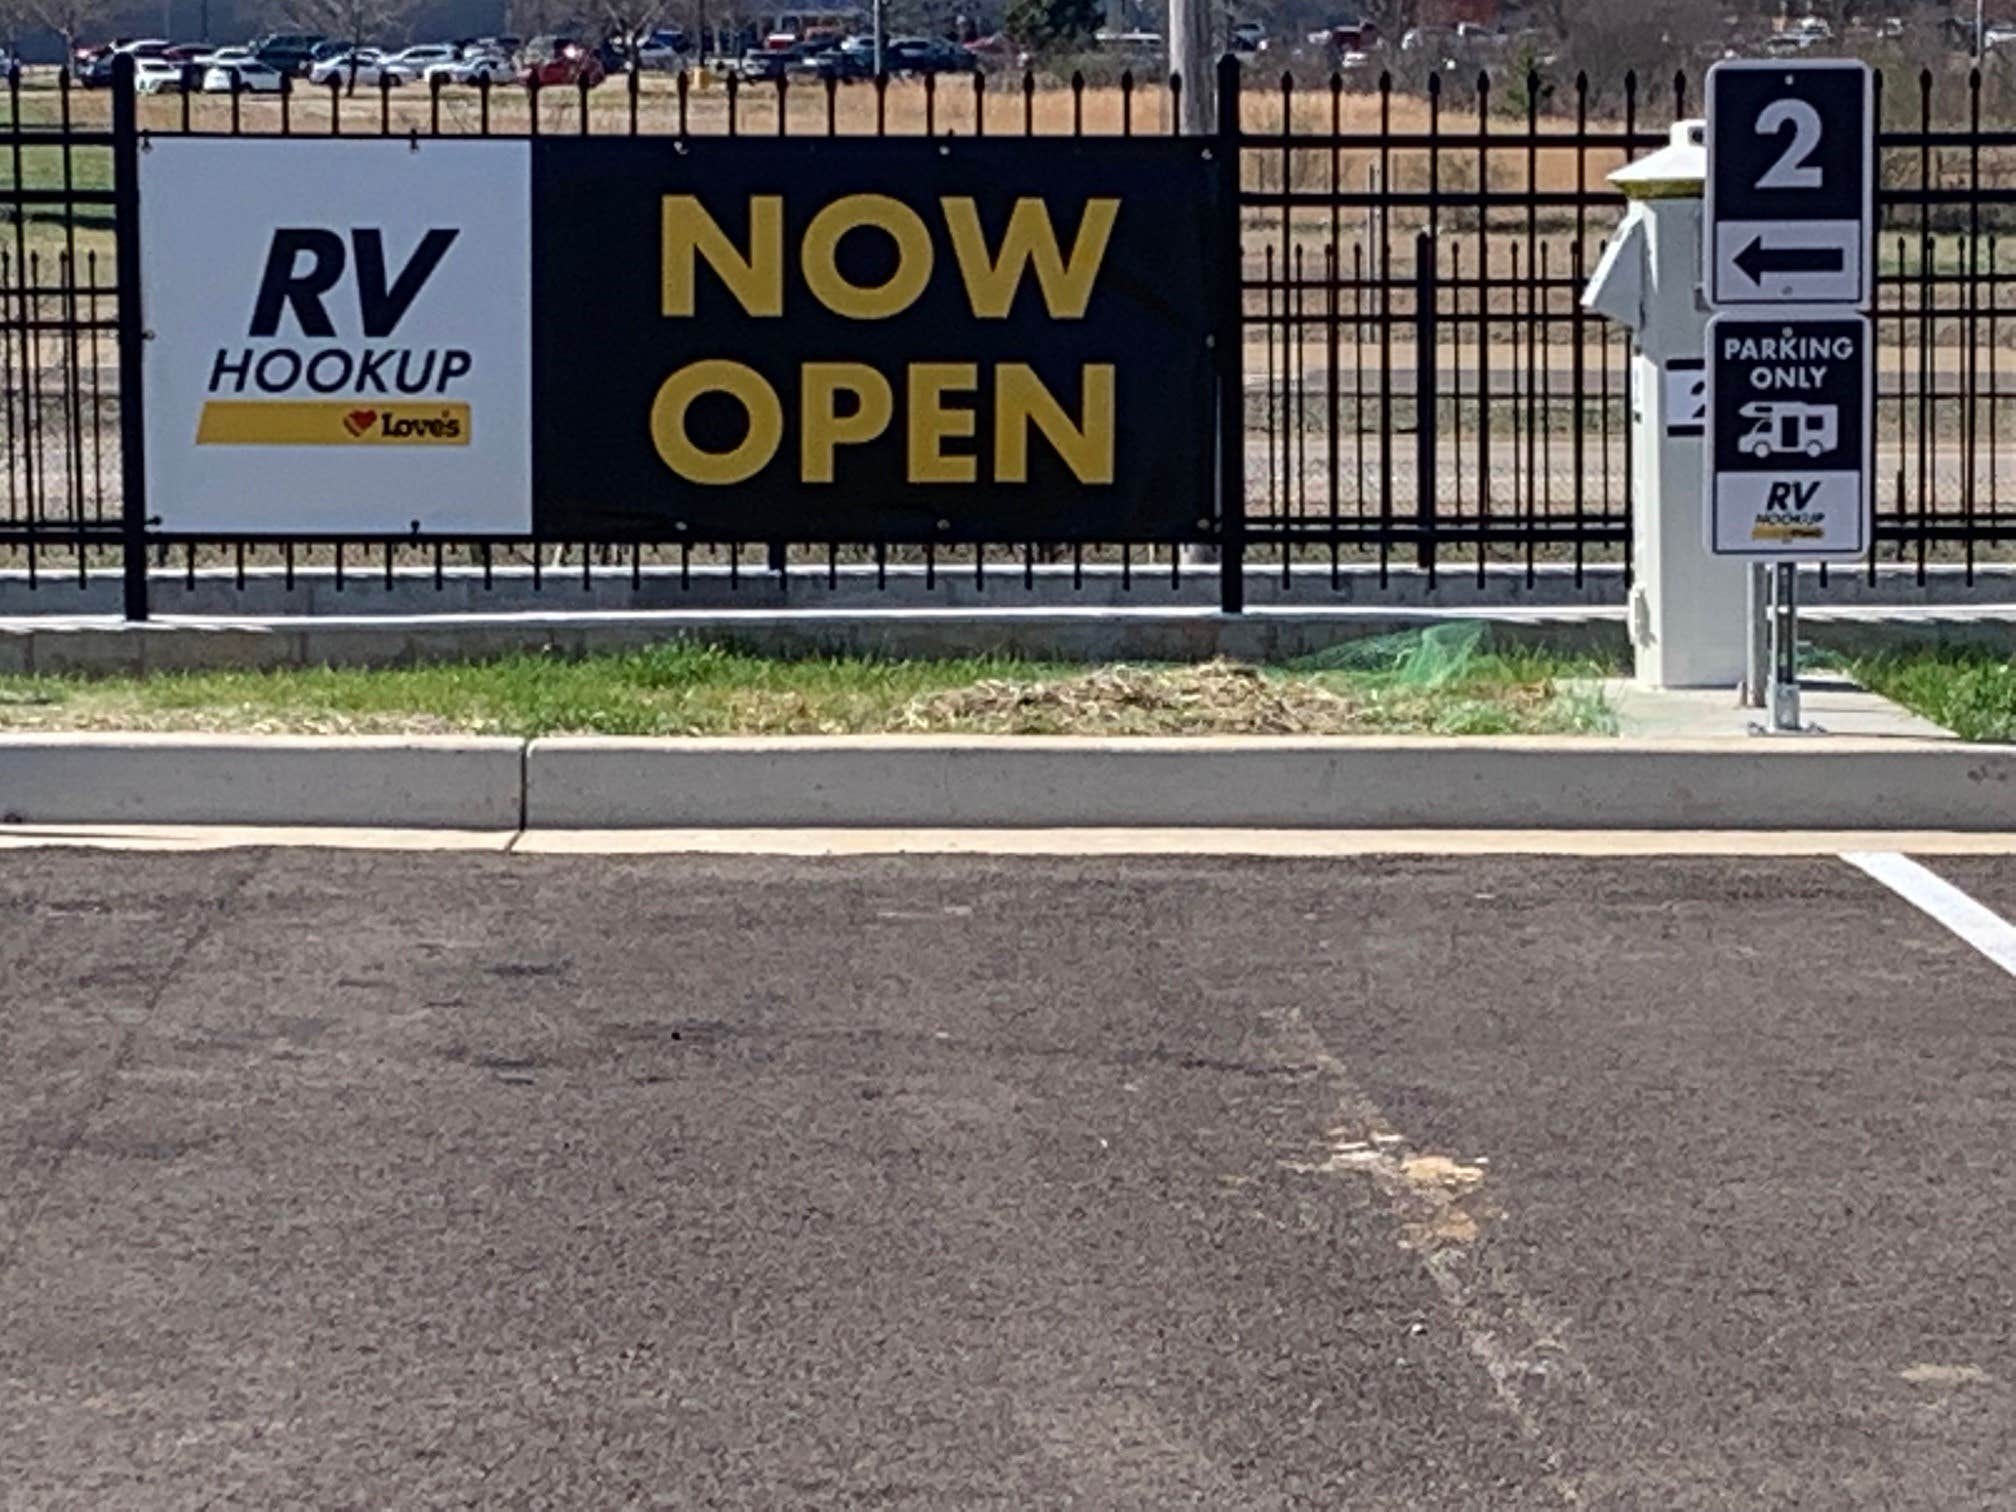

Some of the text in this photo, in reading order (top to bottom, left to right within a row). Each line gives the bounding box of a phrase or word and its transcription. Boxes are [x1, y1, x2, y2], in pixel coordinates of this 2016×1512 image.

[1755, 98, 1823, 188] 2
[661, 194, 1122, 319] NOW
[248, 228, 460, 338] RV
[208, 348, 472, 393] HOOKUP
[1724, 337, 1853, 360] PARKING
[1750, 366, 1827, 390] ONLY
[382, 409, 460, 437] Love's
[650, 359, 1115, 485] OPEN
[1767, 481, 1821, 511] RV
